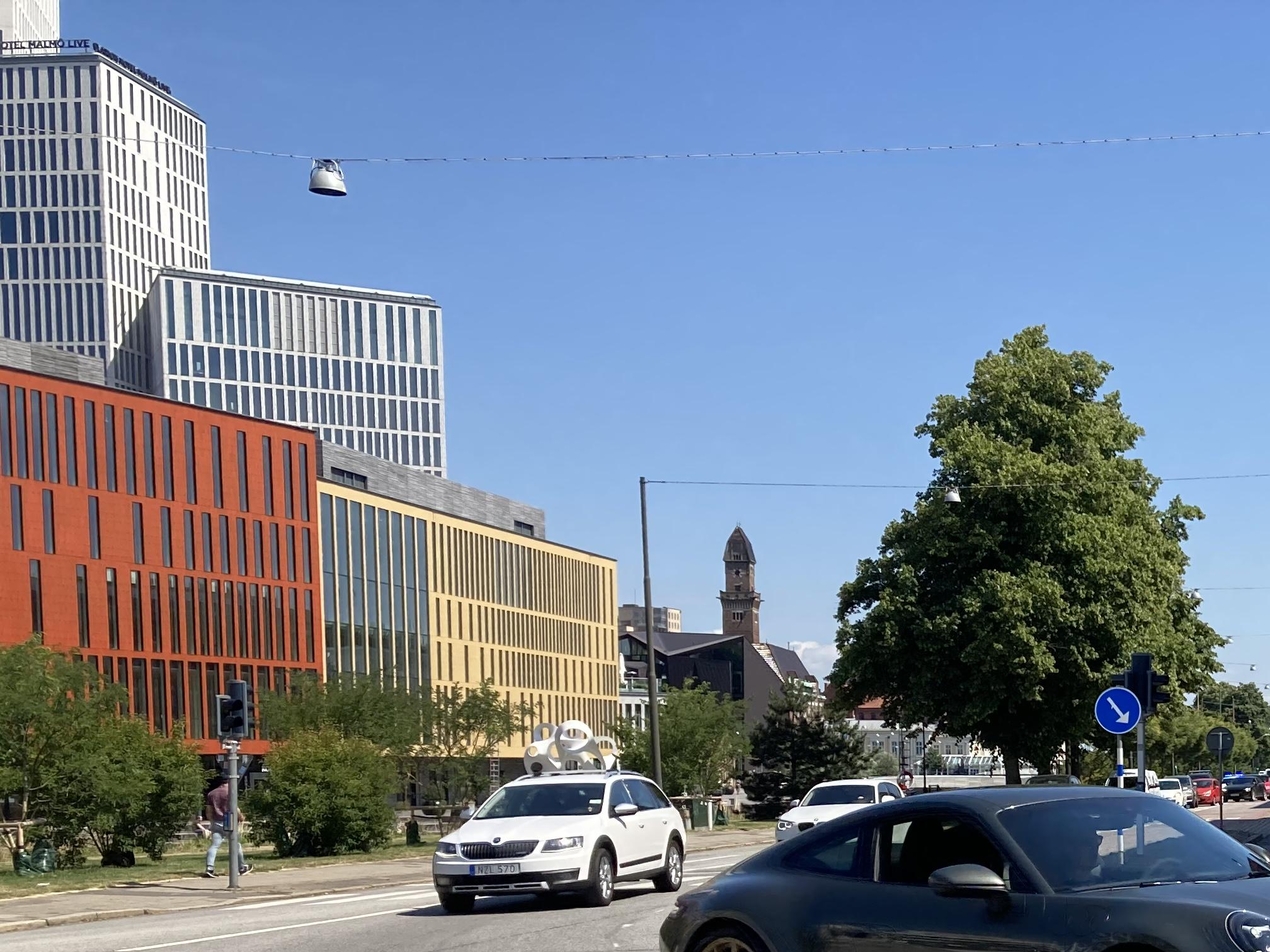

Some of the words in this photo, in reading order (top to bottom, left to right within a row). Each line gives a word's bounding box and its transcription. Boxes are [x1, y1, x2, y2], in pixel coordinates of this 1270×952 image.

[1, 41, 25, 49] OTEL
[68, 39, 90, 48] LIVE
[498, 864, 516, 873] 570
